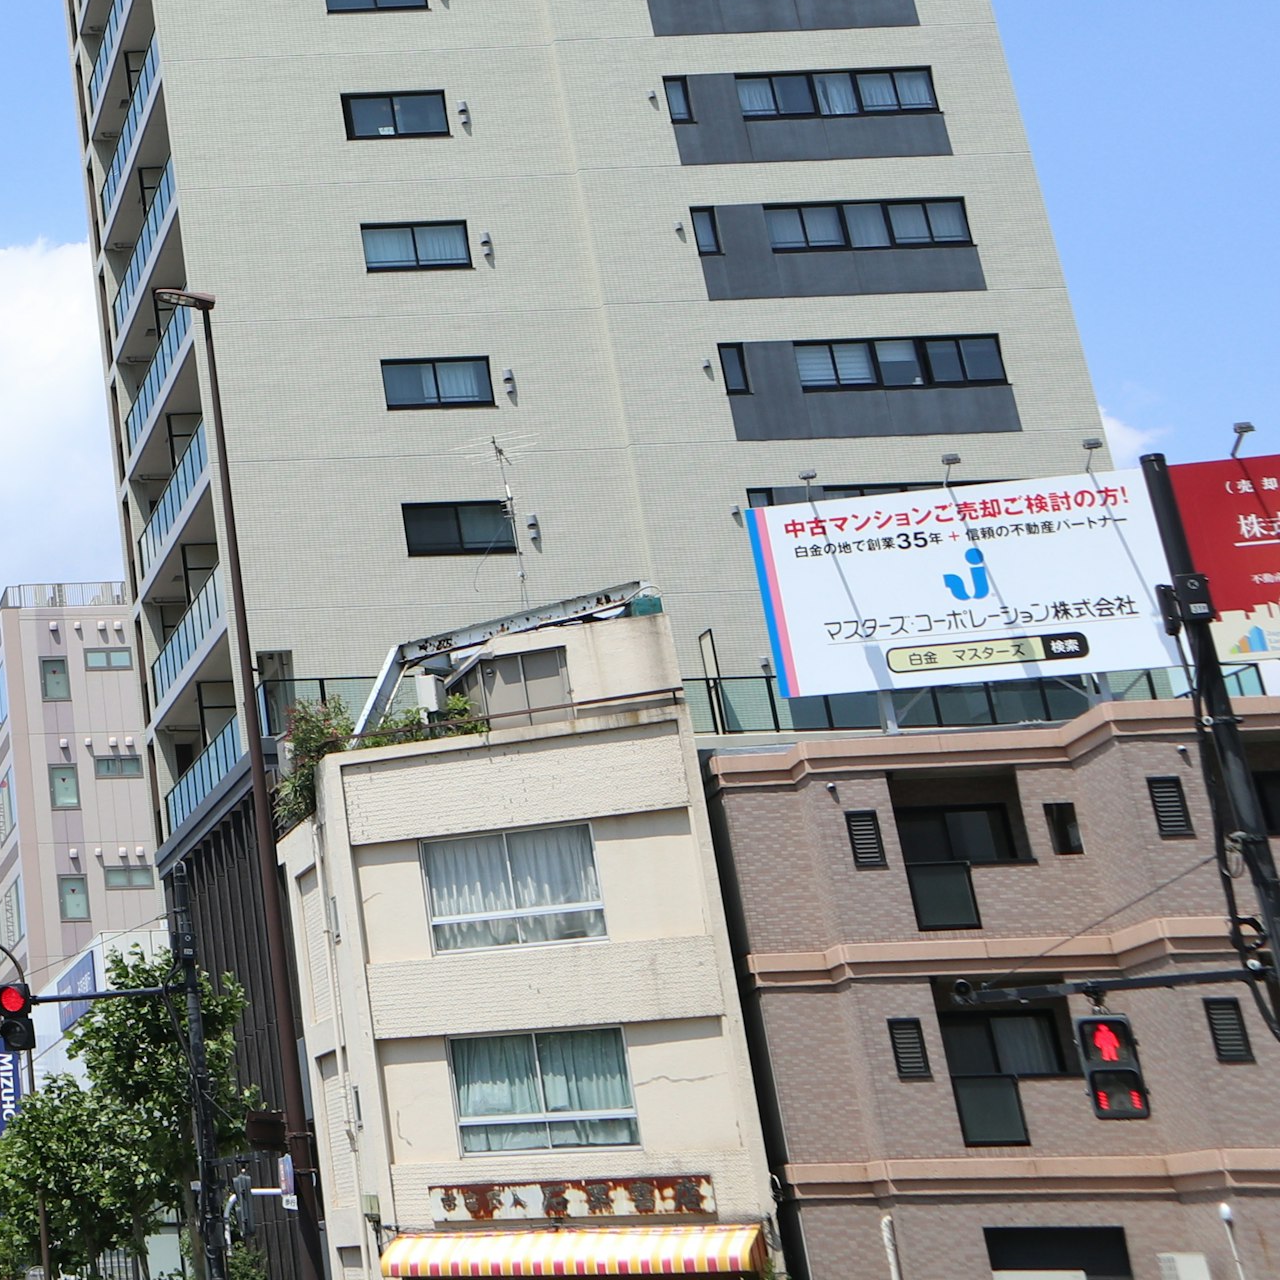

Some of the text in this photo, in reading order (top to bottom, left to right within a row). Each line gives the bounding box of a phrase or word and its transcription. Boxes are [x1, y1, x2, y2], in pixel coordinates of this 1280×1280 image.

[784, 486, 1130, 538] 中古マンションご売却ご検討の方!
[794, 531, 943, 558] 白金の地で創業35年
[965, 514, 1128, 542] 信頼の不動産パートナー
[908, 639, 1081, 666] 白金 マスターズ 検索
